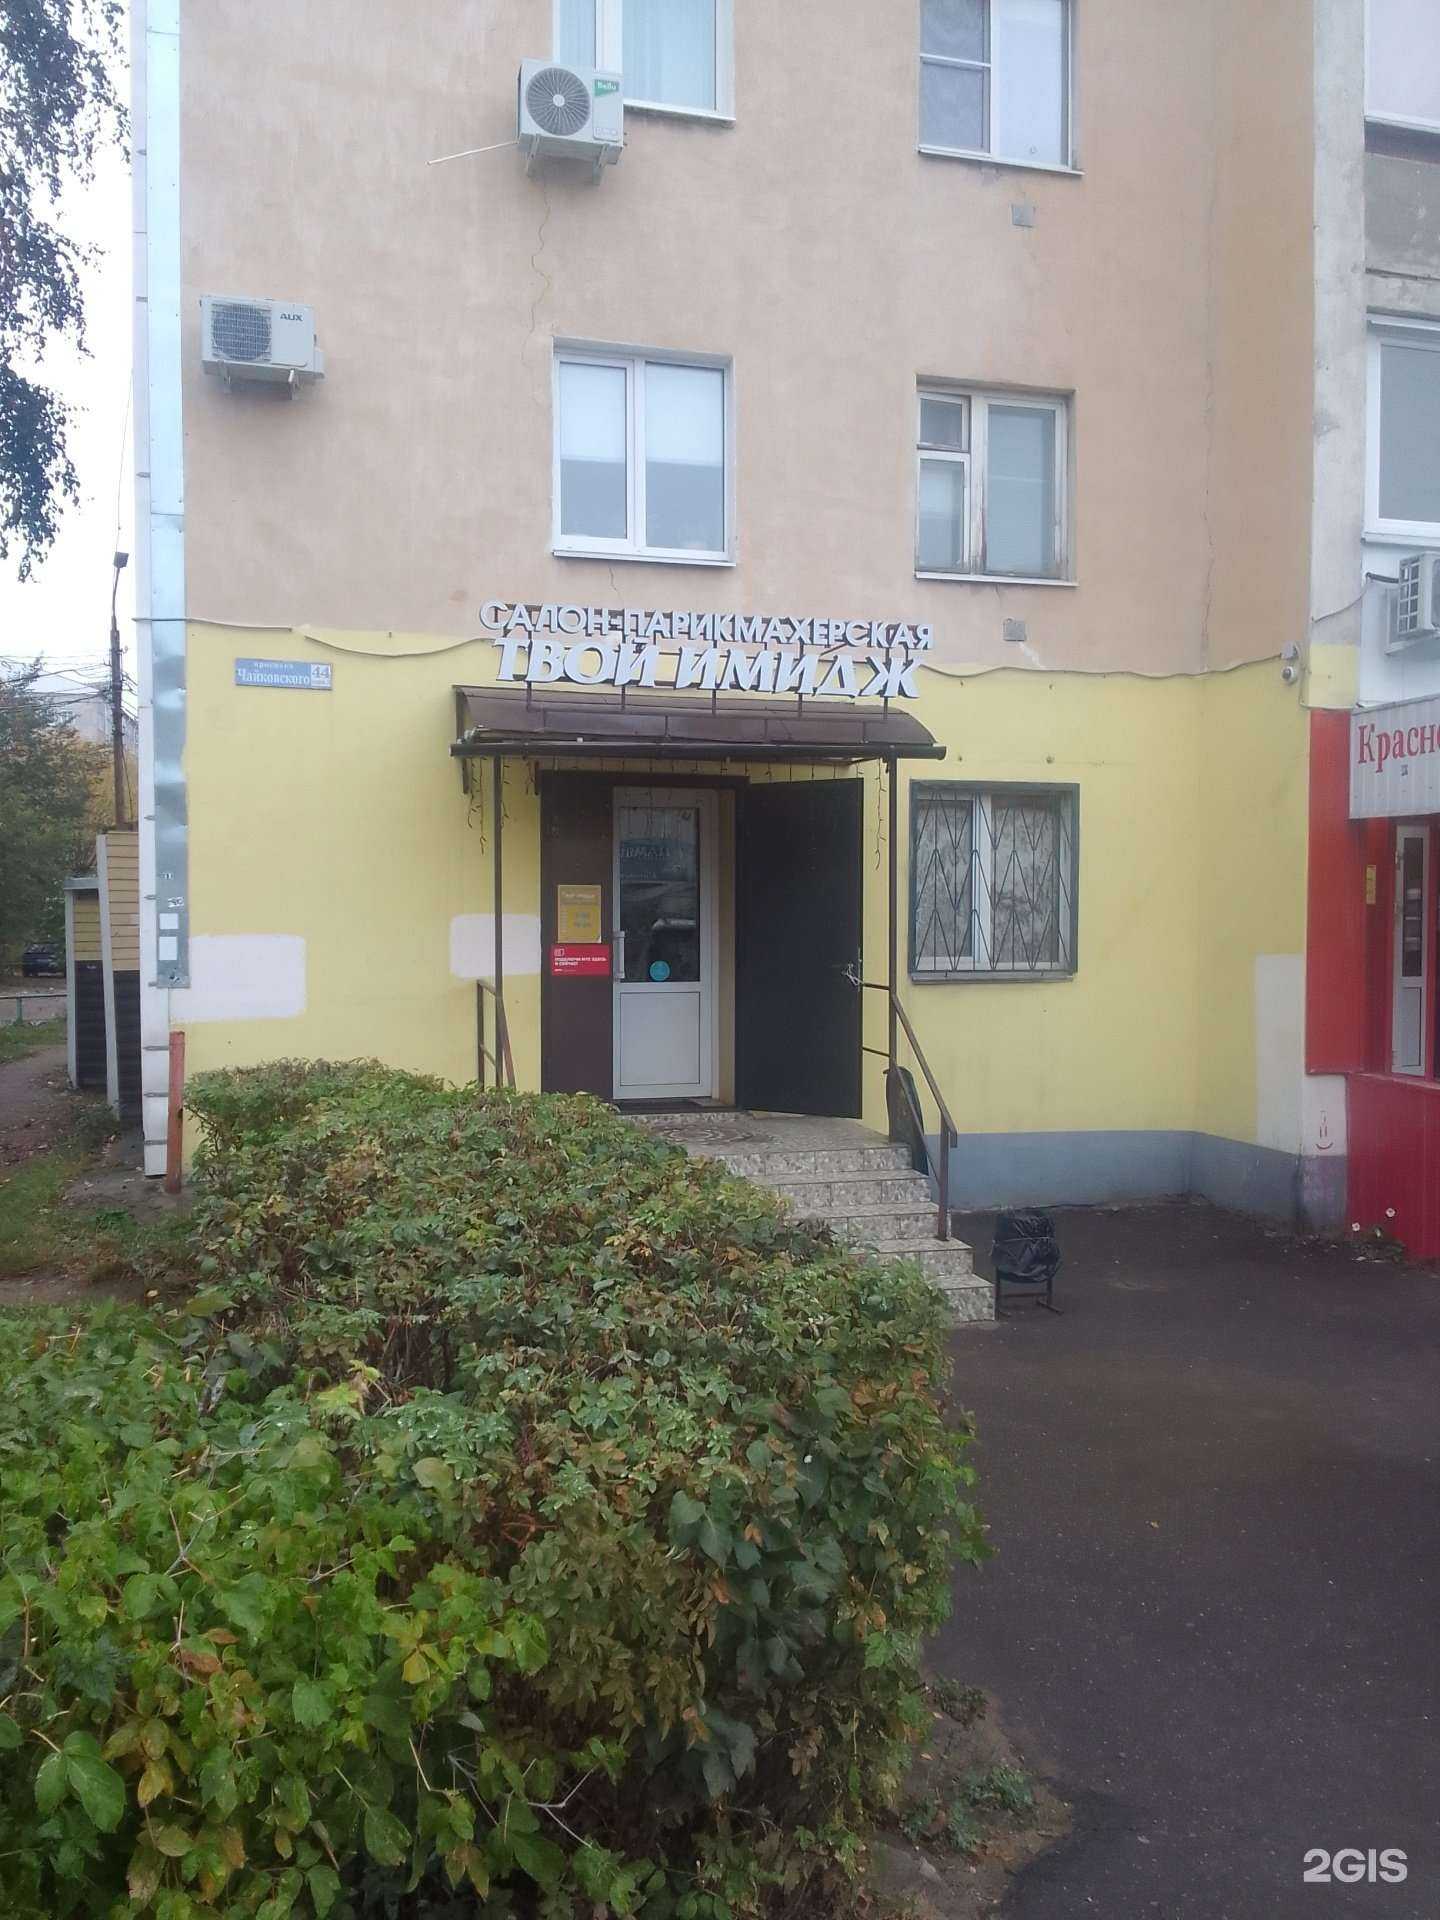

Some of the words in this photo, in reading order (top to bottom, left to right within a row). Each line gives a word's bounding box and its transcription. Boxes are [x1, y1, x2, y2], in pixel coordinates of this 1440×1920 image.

[280, 312, 303, 321] AUX
[478, 600, 934, 649] САЛОН-ПАРИКМАХЕРСКАЯ
[237, 668, 310, 685] Чайковского
[312, 665, 329, 678] 44
[494, 636, 659, 688] ТВОЙ
[674, 645, 922, 701] ИМИДЖ
[1358, 723, 1440, 774] Красн
